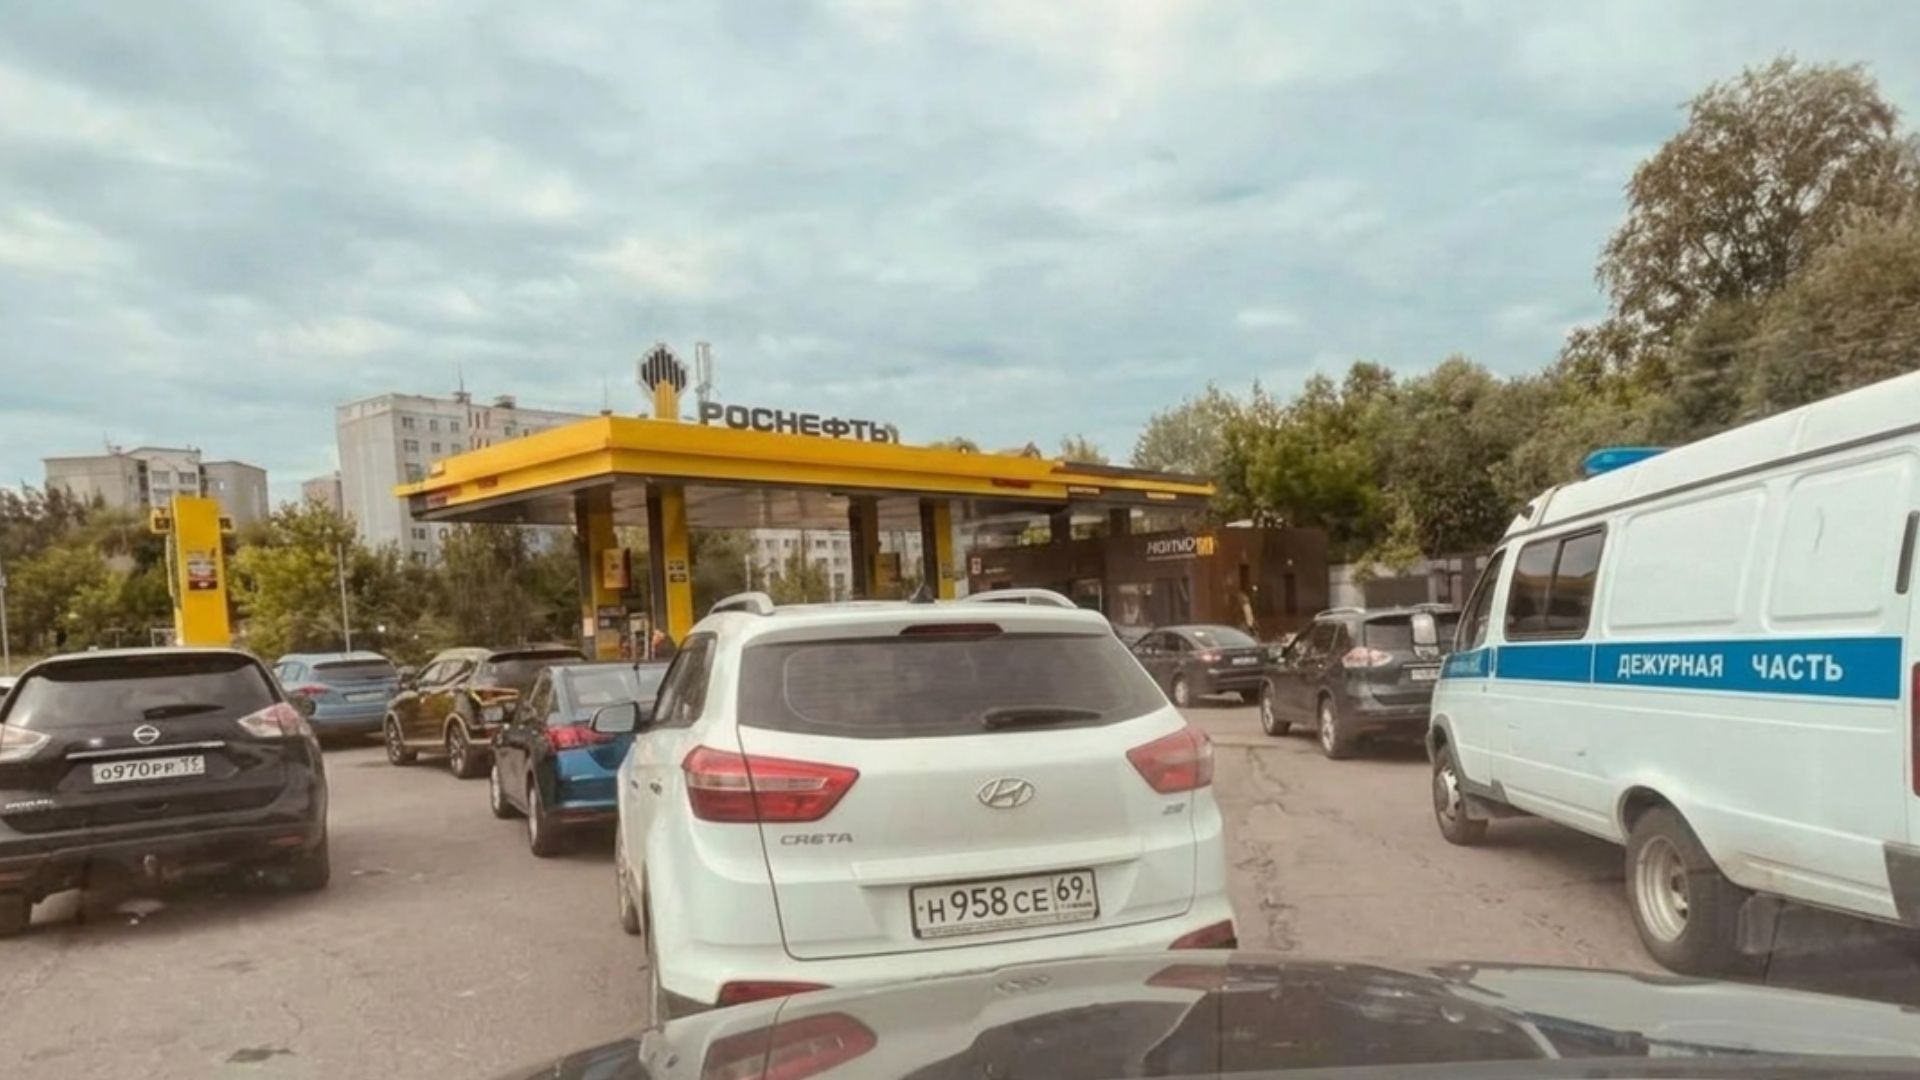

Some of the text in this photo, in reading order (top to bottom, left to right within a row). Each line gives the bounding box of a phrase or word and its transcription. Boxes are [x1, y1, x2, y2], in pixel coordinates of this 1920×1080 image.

[700, 402, 891, 444] РОСНЕФТЬ
[1617, 653, 1843, 681] ДЕЖУРНАЯ ЧАСТЬ
[780, 832, 853, 846] CRETA
